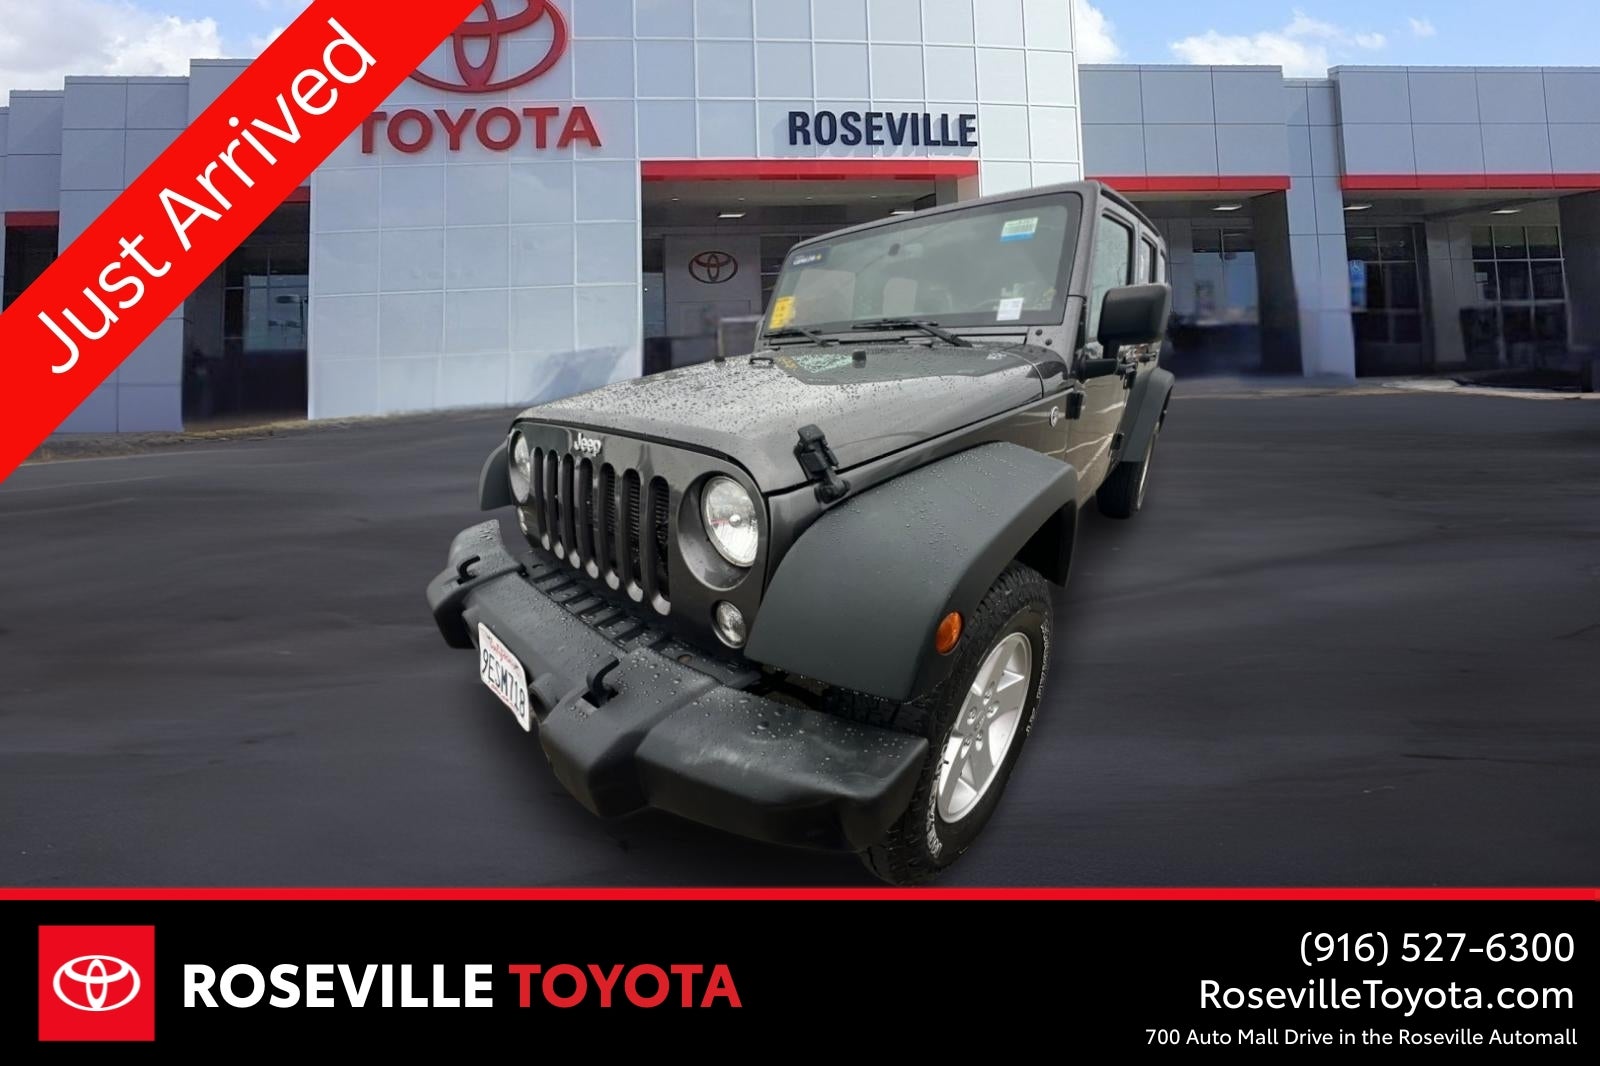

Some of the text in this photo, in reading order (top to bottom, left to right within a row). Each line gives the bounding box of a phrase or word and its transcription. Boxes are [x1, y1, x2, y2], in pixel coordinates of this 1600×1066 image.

[362, 106, 602, 155] TOYOTA
[788, 110, 978, 147] ROSEVILLE
[574, 432, 602, 457] Jeep
[481, 649, 526, 718] 9ESM718
